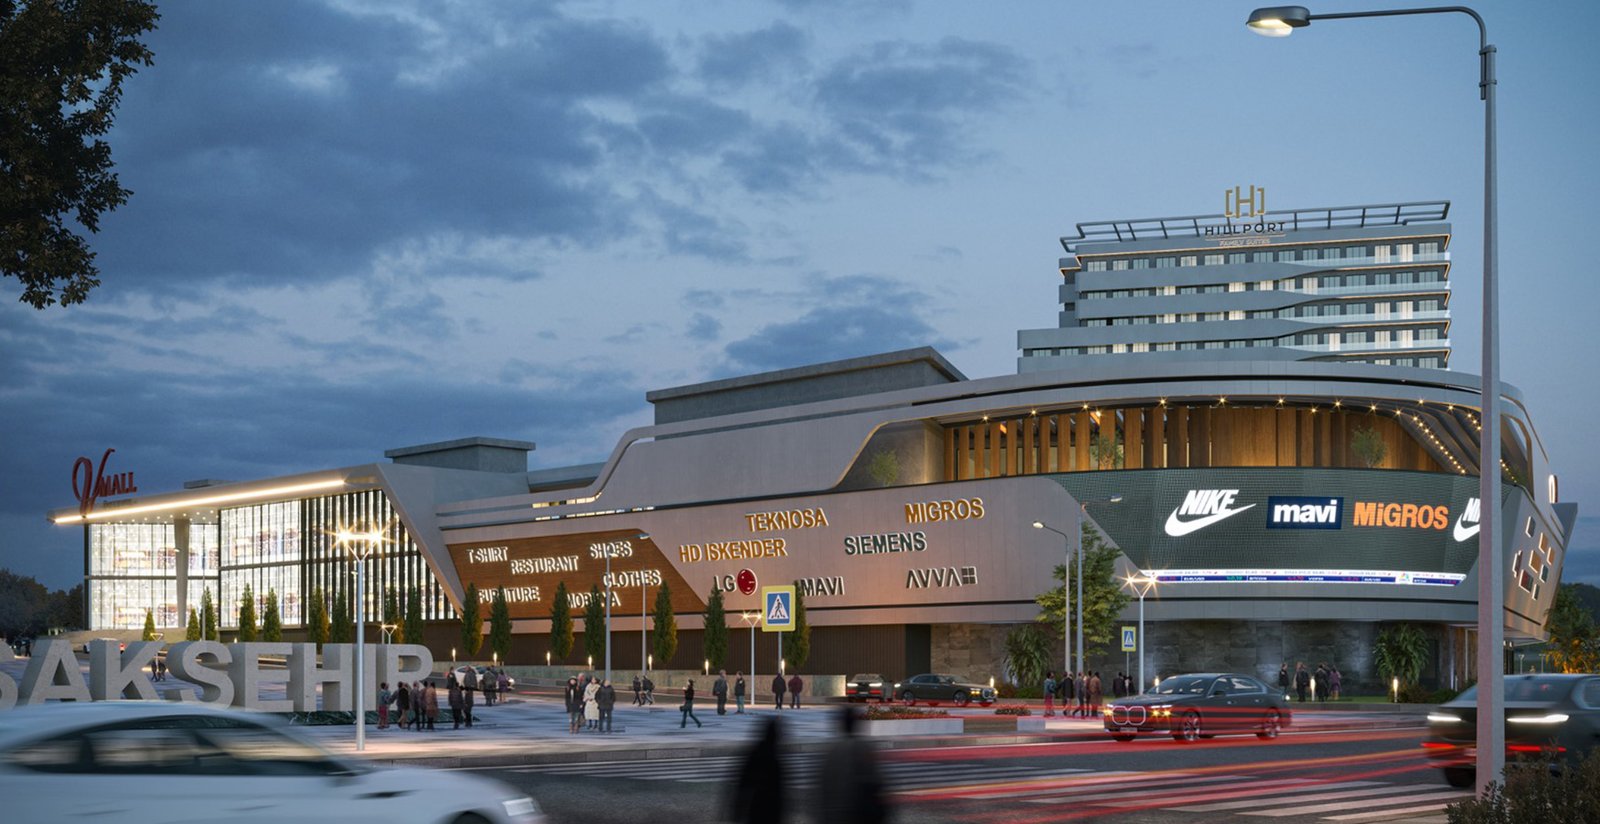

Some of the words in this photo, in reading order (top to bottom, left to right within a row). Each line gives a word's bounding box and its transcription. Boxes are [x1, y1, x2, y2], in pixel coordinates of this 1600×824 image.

[1204, 221, 1285, 236] HILLPORT
[904, 497, 985, 524] MIGROS
[1179, 489, 1240, 516] NIKE
[1273, 499, 1338, 524] mavi
[745, 507, 829, 533] TEKNOSA
[590, 540, 633, 560] SHOES
[679, 543, 703, 563] HD
[705, 538, 788, 562] ISKENDER
[844, 531, 928, 556] SIEMENS
[511, 555, 579, 575] RESTURANT
[603, 569, 662, 589] CLOTHES
[714, 574, 738, 592] LG
[801, 575, 846, 597] MAVI
[906, 566, 963, 590] AVVA
